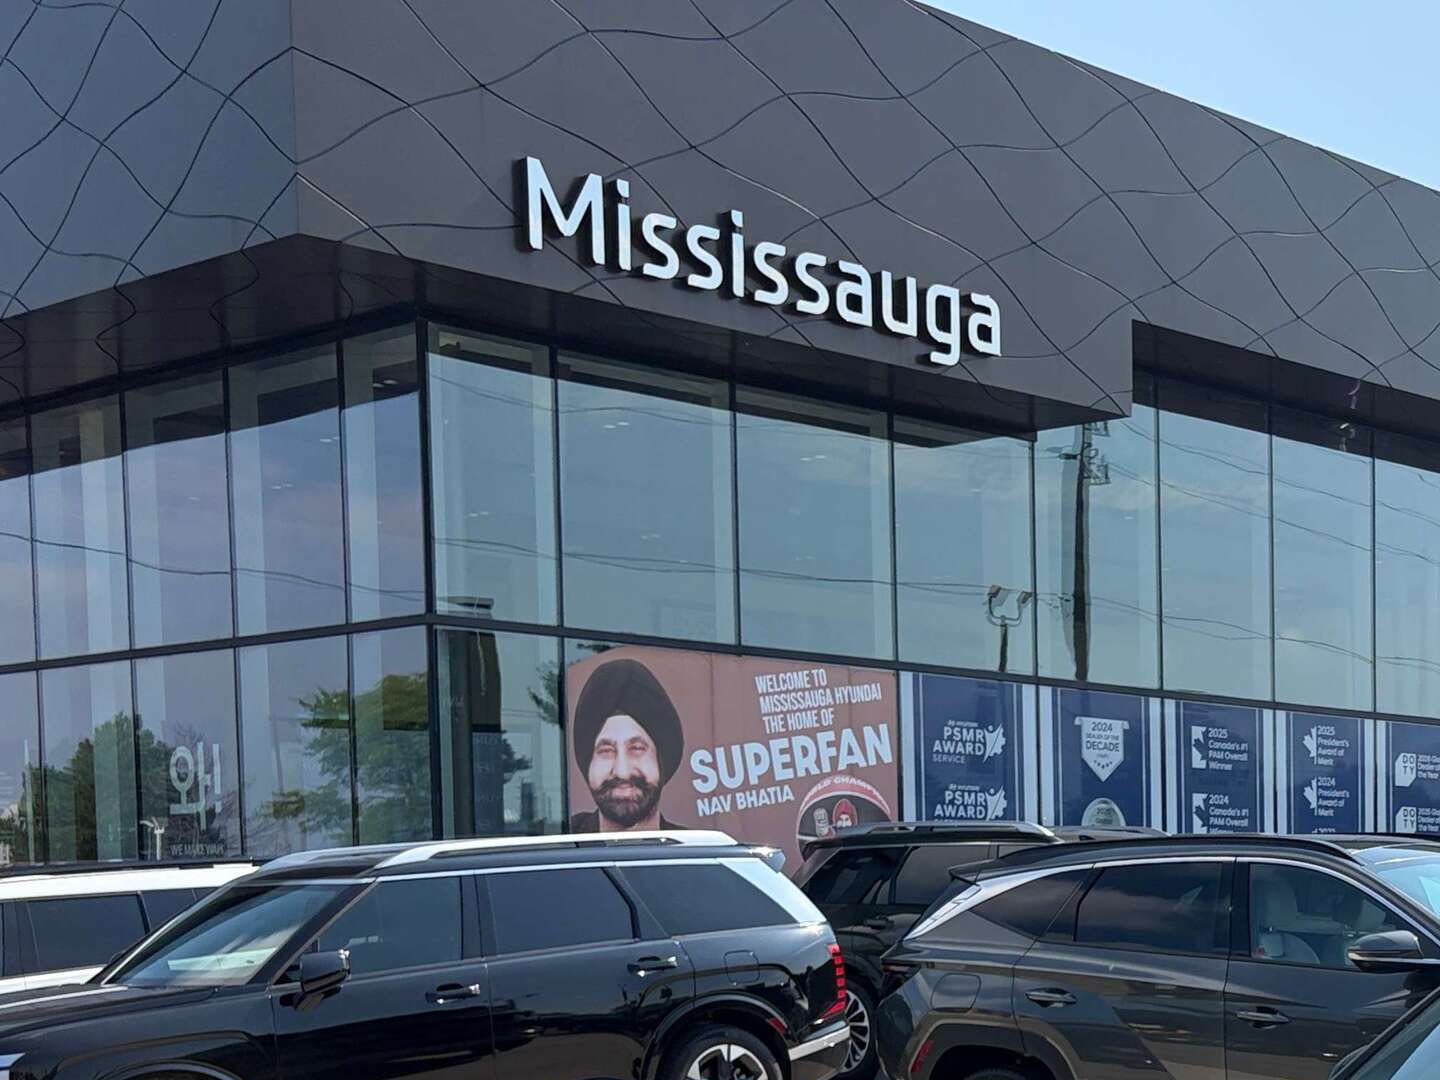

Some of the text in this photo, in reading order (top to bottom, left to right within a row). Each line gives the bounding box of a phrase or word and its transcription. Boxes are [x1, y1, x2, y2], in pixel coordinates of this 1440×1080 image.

[524, 156, 1001, 366] Mississauga
[755, 669, 827, 694] WELCOME TO
[760, 683, 882, 714] MISSISSAUGA HYUNDAI
[762, 708, 835, 735] THE HOME OF
[1092, 721, 1113, 732] 2024
[943, 726, 984, 743] PSMR
[932, 740, 984, 756] AWARD
[1085, 740, 1120, 752] DECADE
[690, 723, 893, 793] SUPERFAN
[932, 753, 966, 764] SERVICE
[1208, 760, 1233, 770] Winner
[697, 784, 795, 817] NAV BHATIA
[945, 790, 986, 806] PSMR
[1209, 793, 1229, 805] 2024
[934, 803, 986, 819] AWARD
